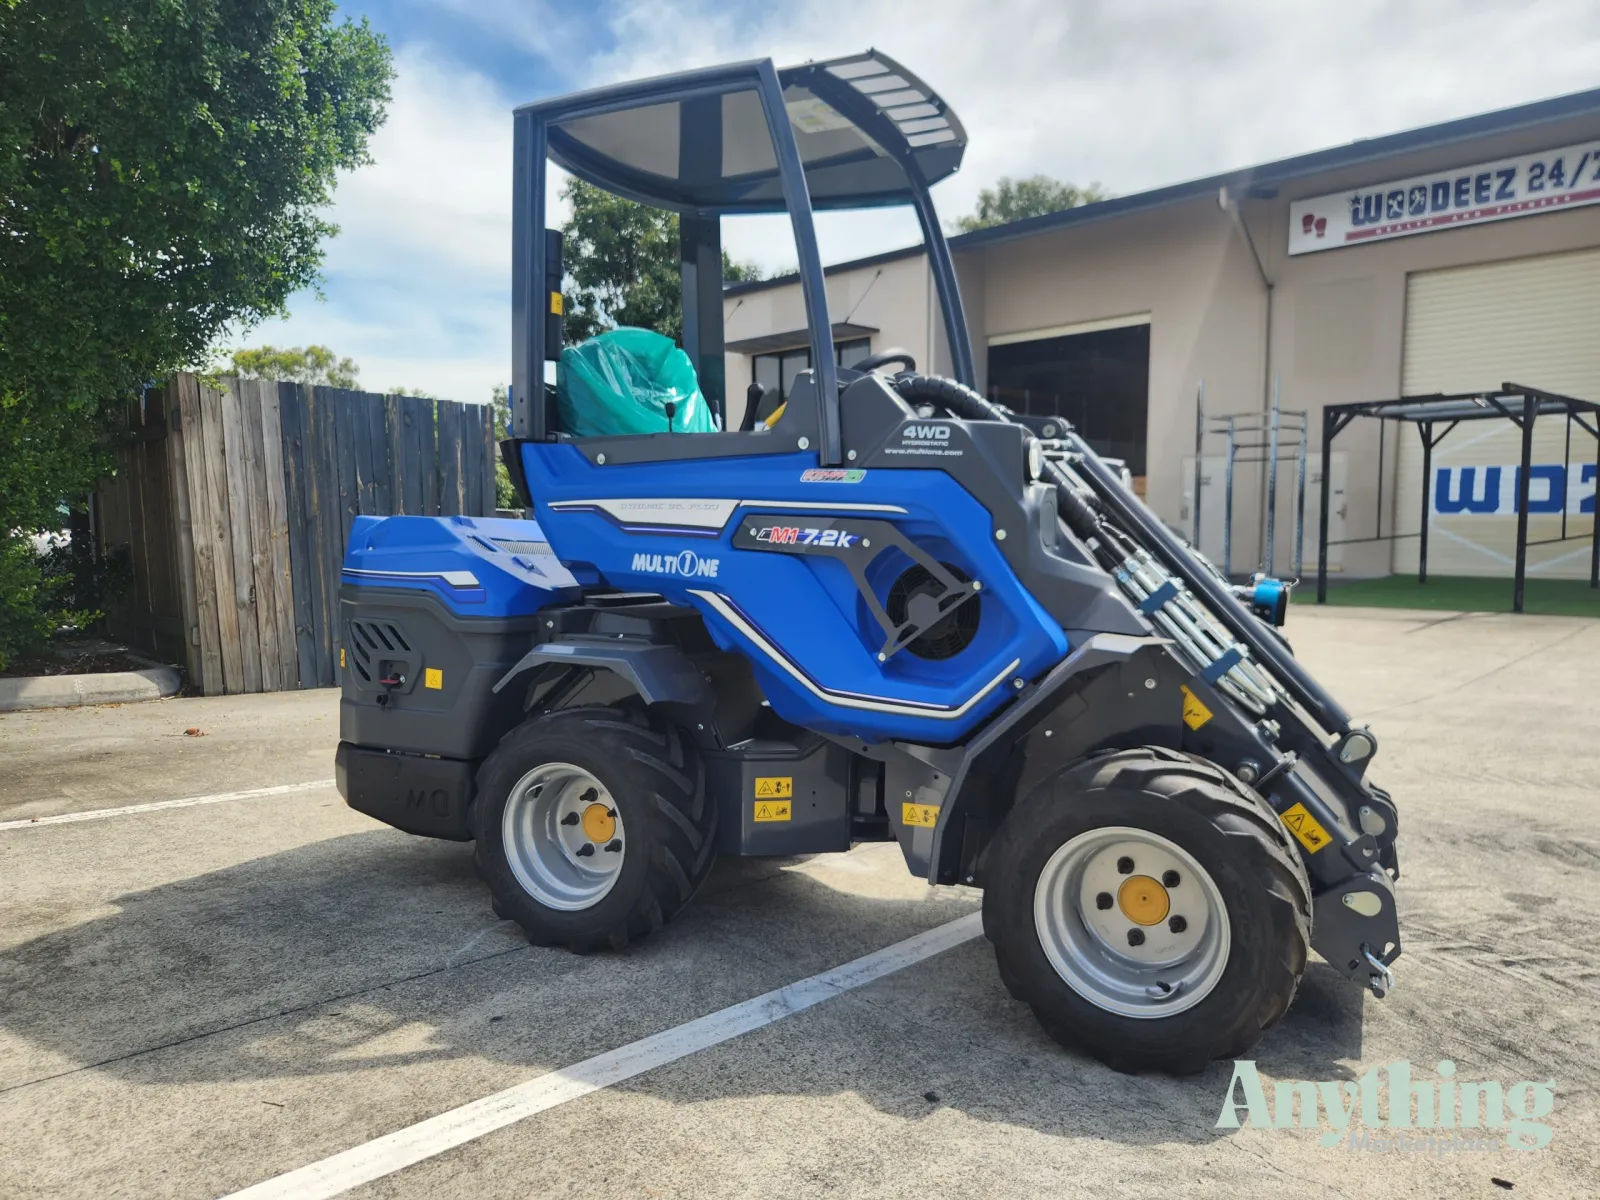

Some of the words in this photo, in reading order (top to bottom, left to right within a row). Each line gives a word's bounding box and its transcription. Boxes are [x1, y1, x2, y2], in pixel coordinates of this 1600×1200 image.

[903, 425, 951, 440] 4WD
[884, 448, 964, 457] www.multione.com
[768, 526, 799, 545] M1
[802, 528, 853, 548] 7.2k
